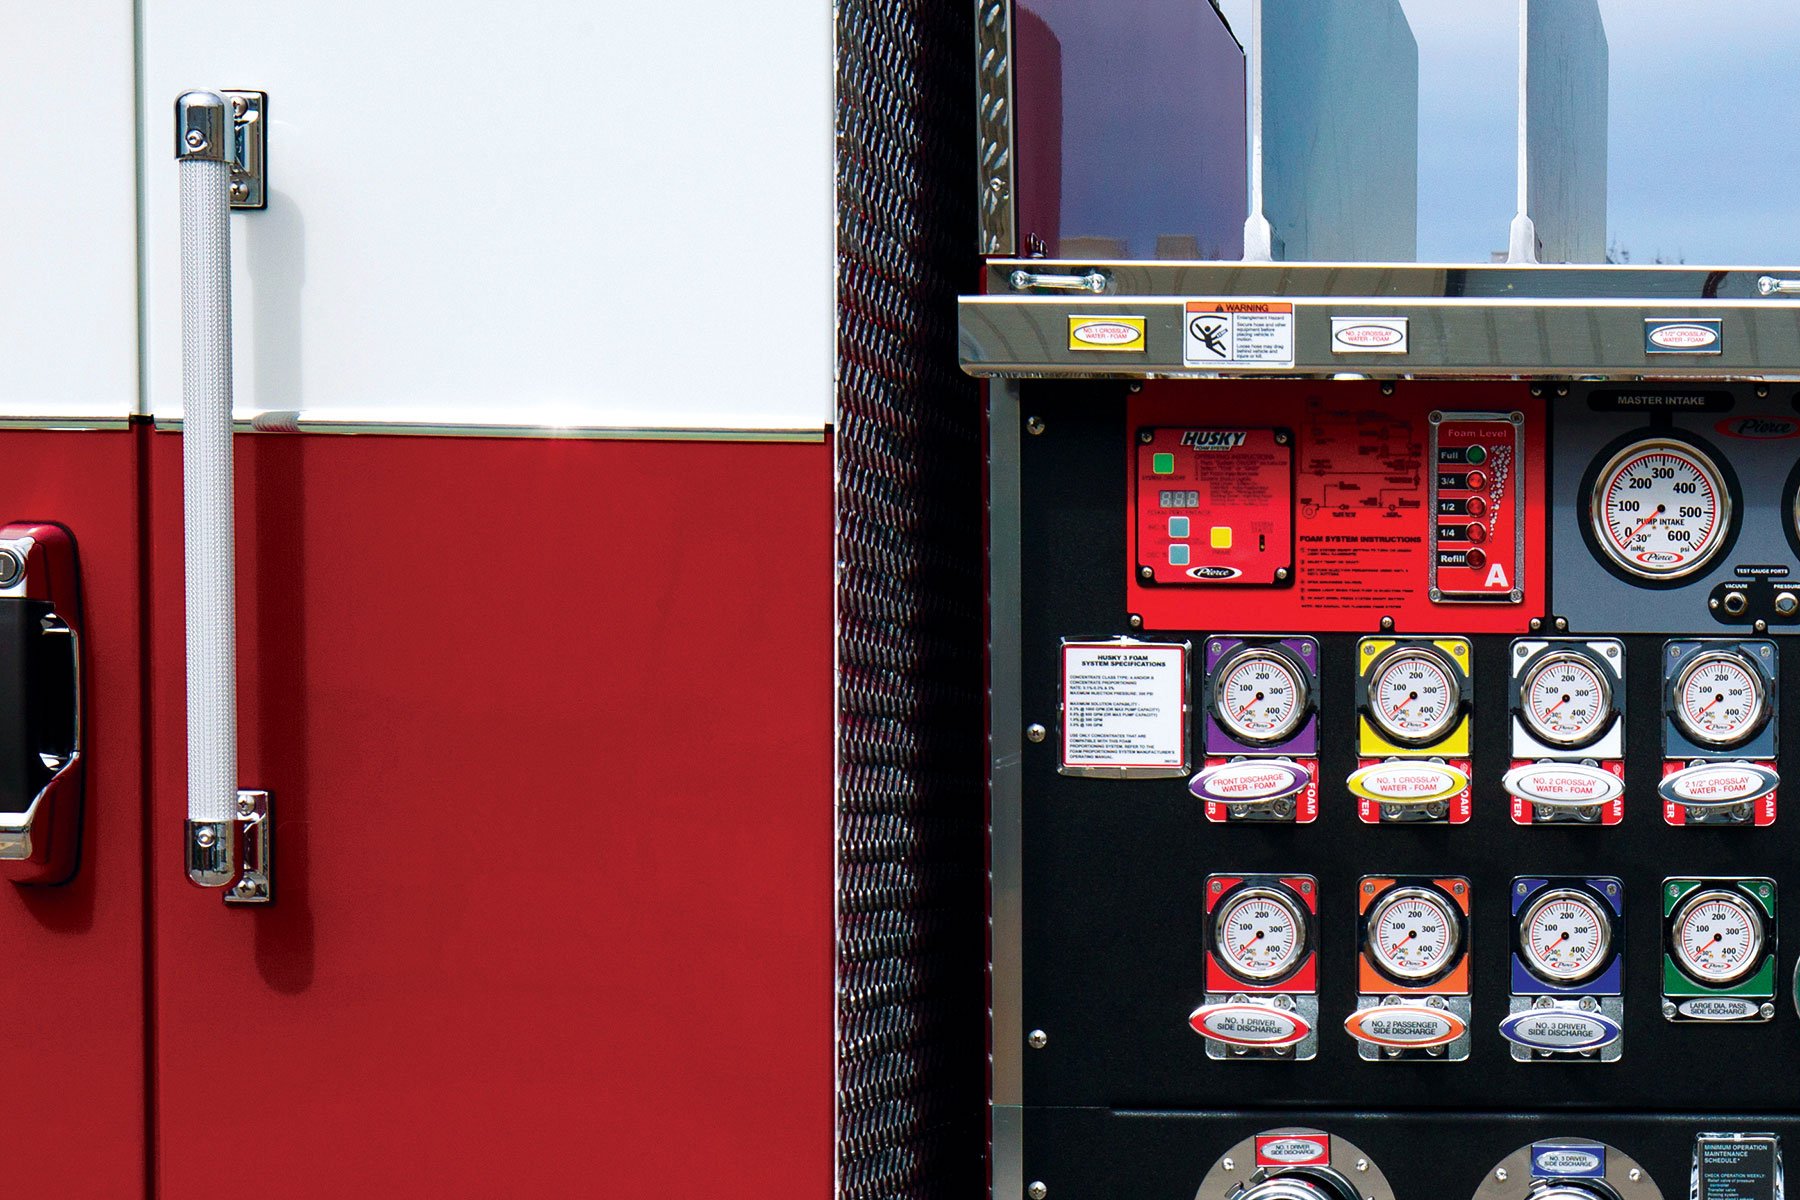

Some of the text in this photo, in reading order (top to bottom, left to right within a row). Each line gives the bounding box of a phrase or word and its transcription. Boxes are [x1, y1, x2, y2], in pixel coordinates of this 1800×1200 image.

[1226, 303, 1269, 313] WARNING
[1618, 396, 1705, 405] MASTER INTAKE
[1737, 418, 1791, 434] Pierce
[1182, 432, 1245, 446] HUSKY
[1448, 429, 1507, 438] Foam Level
[1651, 467, 1675, 479] 300
[1440, 477, 1455, 485] 3/4
[1629, 478, 1652, 489] 200
[1673, 482, 1696, 494] 400
[1441, 503, 1455, 511] 1/2
[1618, 500, 1640, 512] 100
[1679, 507, 1702, 518] 500
[1659, 518, 1685, 526] INTAKE
[1441, 529, 1455, 537] 1/4
[1667, 530, 1691, 542] 600
[1440, 555, 1465, 563] Refill
[1198, 568, 1230, 578] Pierce
[1485, 563, 1509, 587] A
[1212, 773, 1284, 786] FRONT DISCHARGE
[1398, 776, 1440, 784] CROSSLAY
[1221, 784, 1248, 793] WATER
[1253, 782, 1277, 790] FOAM
[1308, 783, 1316, 814] FOAM
[1393, 1021, 1438, 1029] PASSENGER
